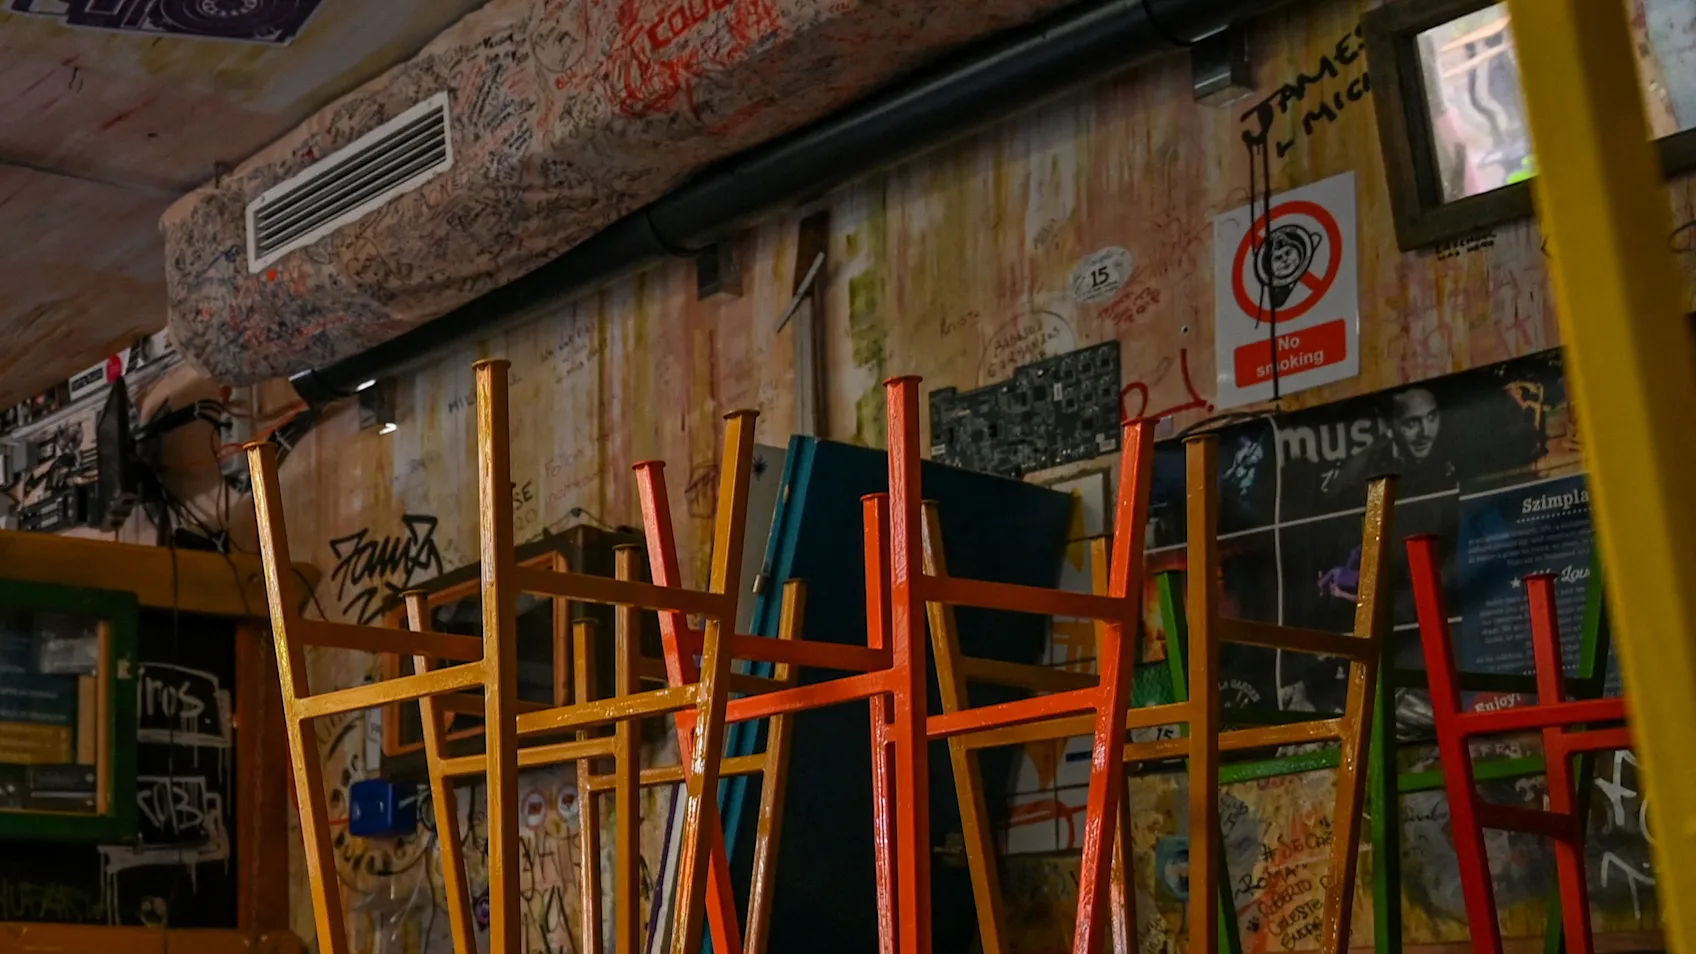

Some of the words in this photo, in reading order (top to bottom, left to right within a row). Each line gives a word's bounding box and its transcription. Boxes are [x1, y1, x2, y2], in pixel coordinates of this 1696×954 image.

[1090, 265, 1110, 289] 15
[1277, 335, 1301, 352] No
[1256, 349, 1324, 379] smoking
[1521, 487, 1590, 514] Szimpla
